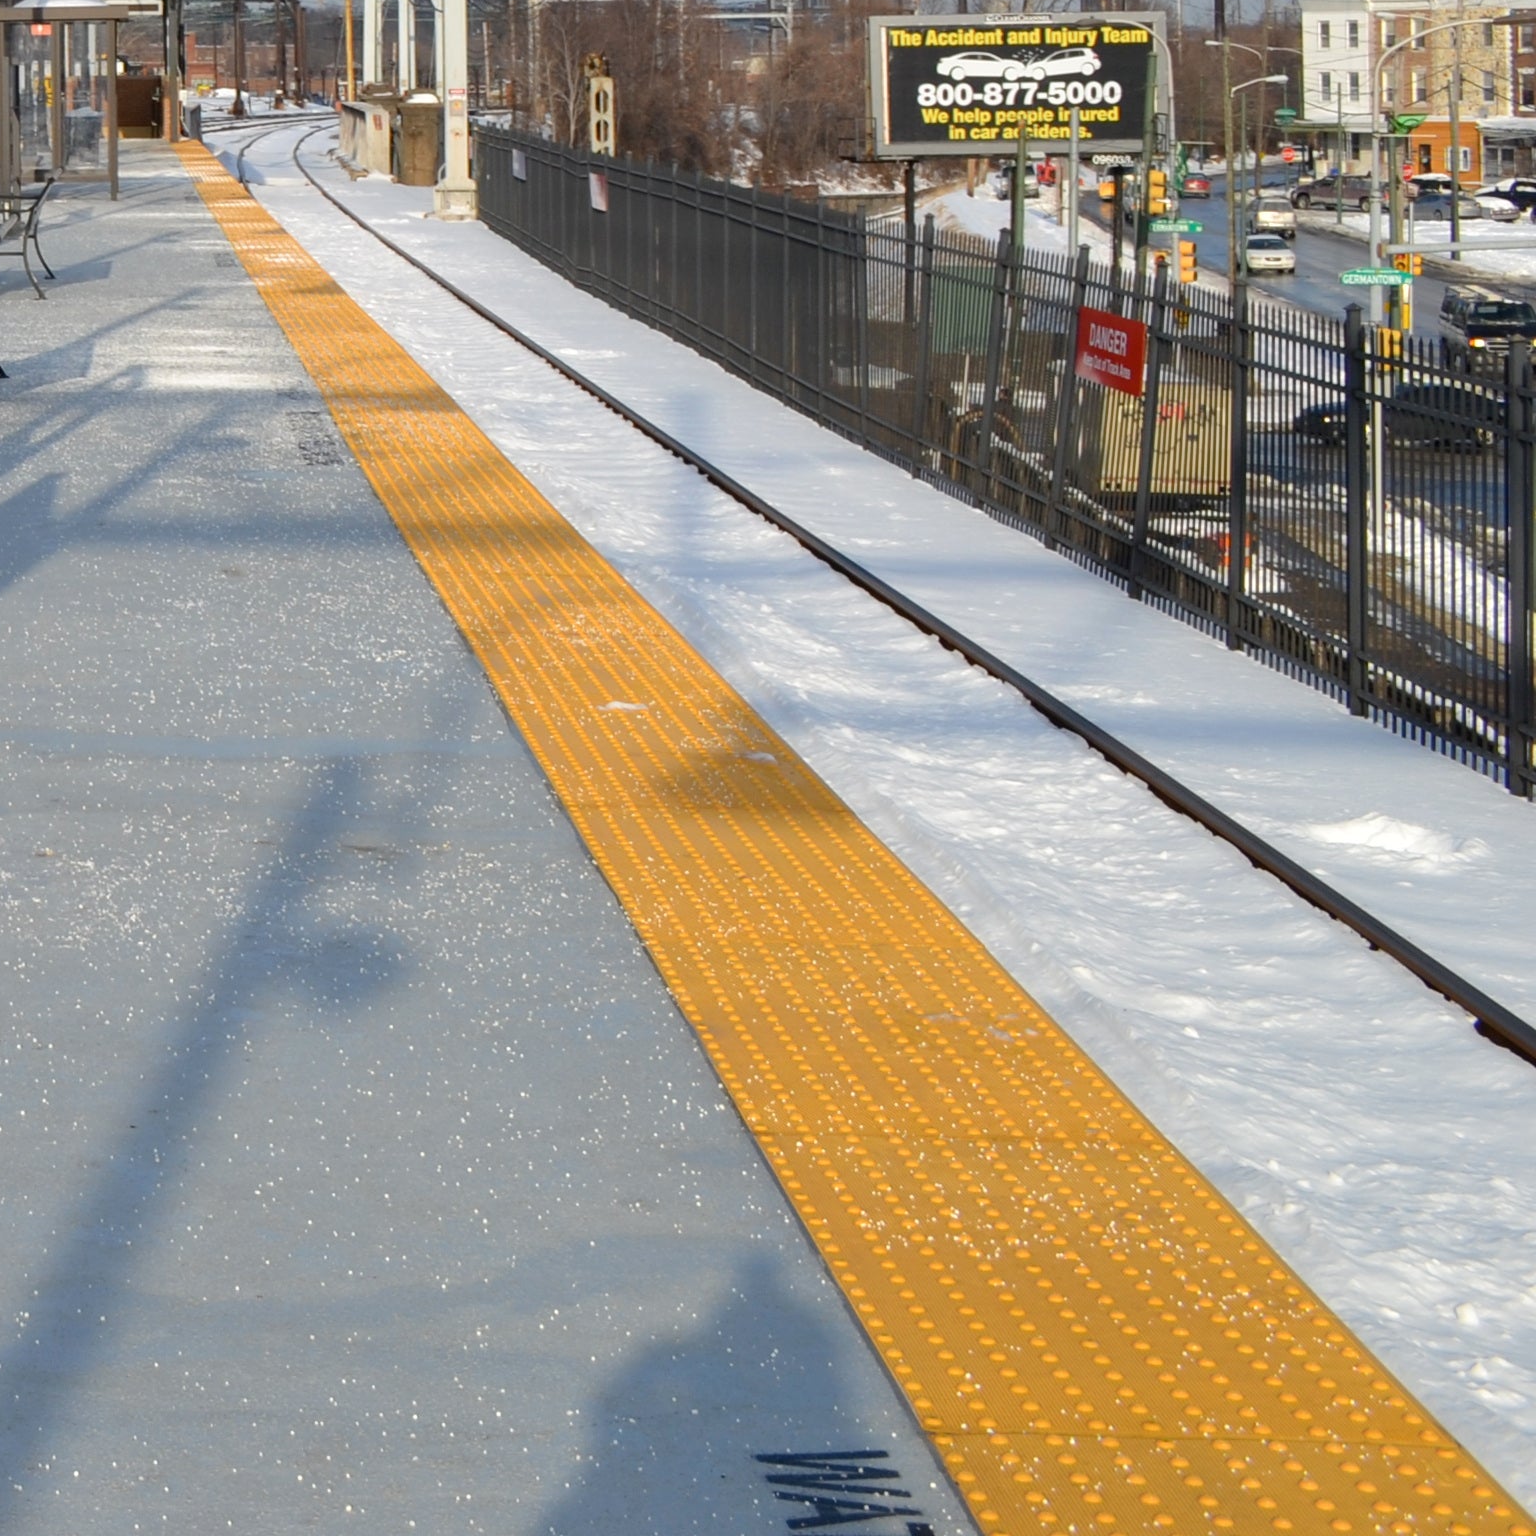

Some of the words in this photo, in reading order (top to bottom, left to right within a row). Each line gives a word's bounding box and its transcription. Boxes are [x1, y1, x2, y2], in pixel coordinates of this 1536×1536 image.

[890, 30, 922, 47] The
[925, 29, 1004, 46] Accident
[1008, 27, 1041, 45] and
[1044, 27, 1098, 47] Injury
[1100, 26, 1148, 44] Team
[916, 81, 1122, 106] 800-877-5000
[922, 108, 950, 124] We
[952, 107, 992, 126] help
[1059, 105, 1120, 123] inured
[949, 125, 966, 140] in
[969, 126, 998, 140] car
[1342, 274, 1402, 284] GERMANTOWN
[1089, 323, 1127, 356] DANGER
